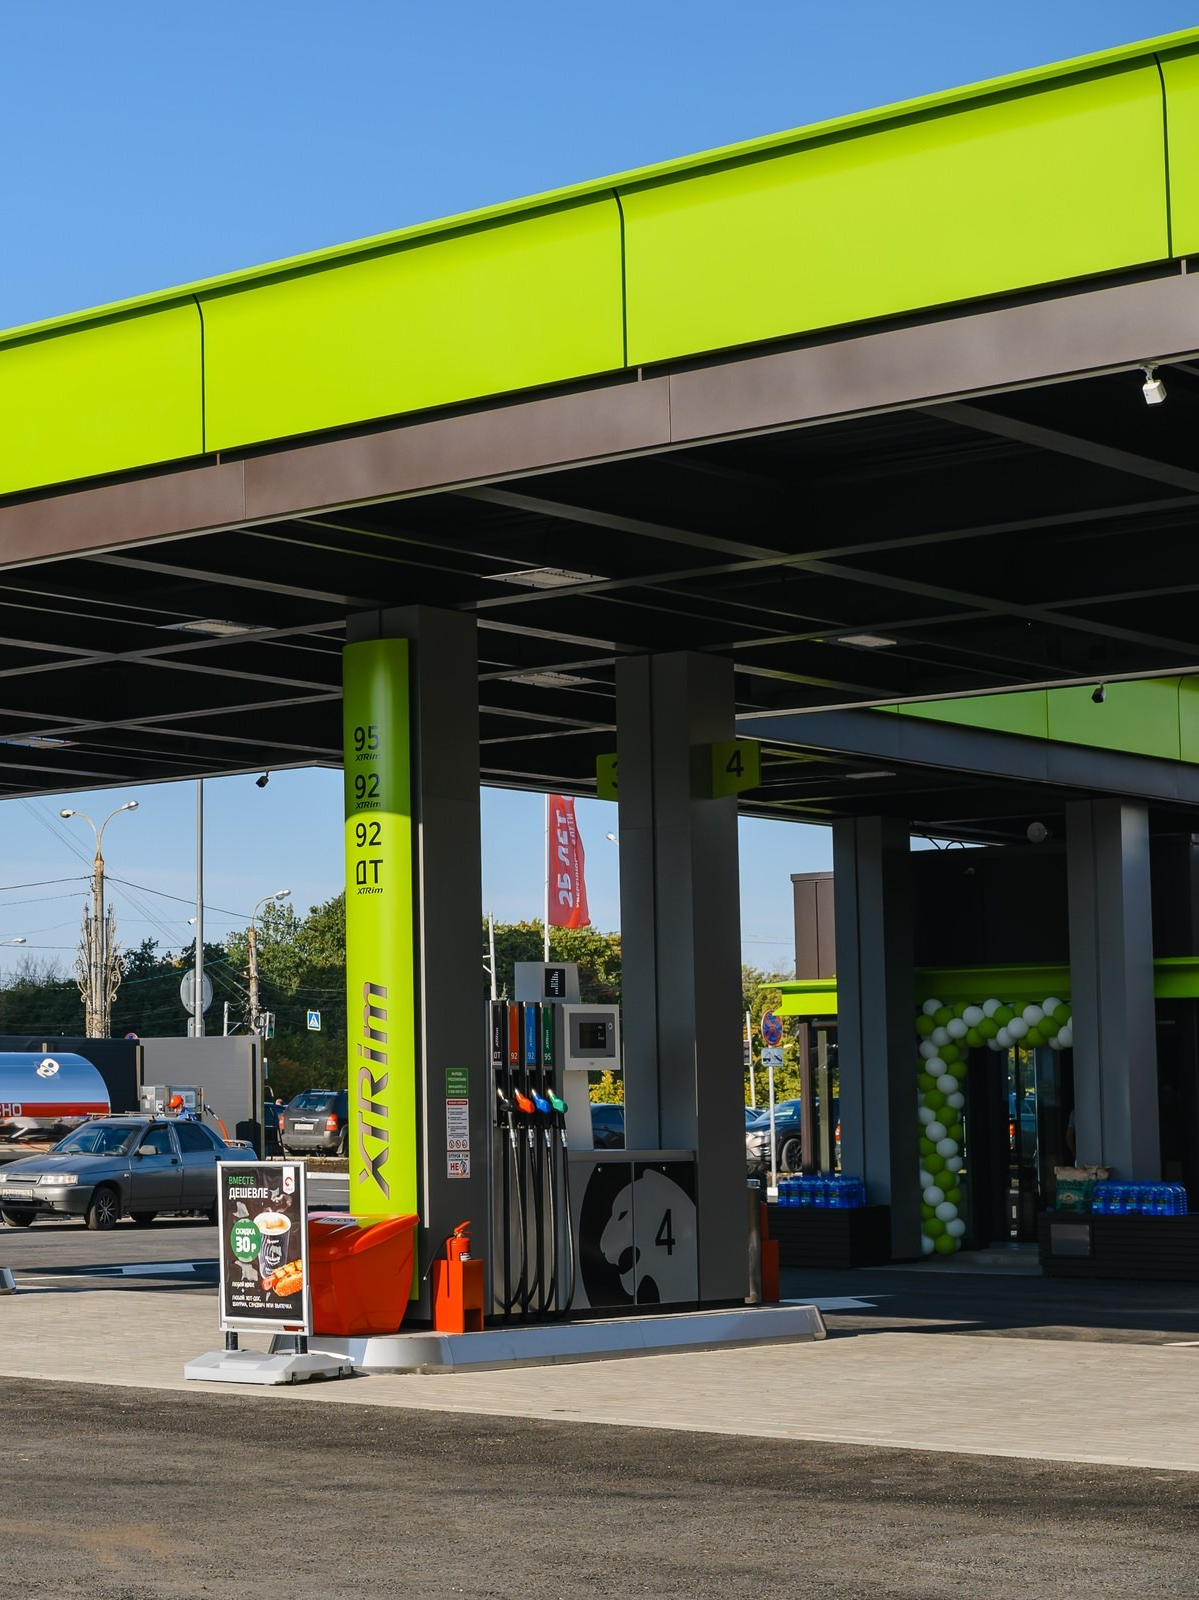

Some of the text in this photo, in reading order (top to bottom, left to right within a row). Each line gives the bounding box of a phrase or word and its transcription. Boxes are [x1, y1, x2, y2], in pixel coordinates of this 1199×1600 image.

[354, 726, 381, 752] 95
[725, 750, 745, 777] 4
[355, 773, 381, 799] 92
[355, 821, 382, 848] 92
[555, 809, 571, 867] ЛЕТ
[356, 859, 383, 885] ДТ
[557, 873, 574, 908] 25
[357, 981, 390, 1201] XTRim
[228, 1176, 254, 1184] ВМЕСТЕ
[450, 1163, 459, 1171] НЕ
[229, 1187, 269, 1200] ДЕШЕВЛЕ
[235, 1228, 256, 1236] СКИДКА
[655, 1208, 676, 1256] 4
